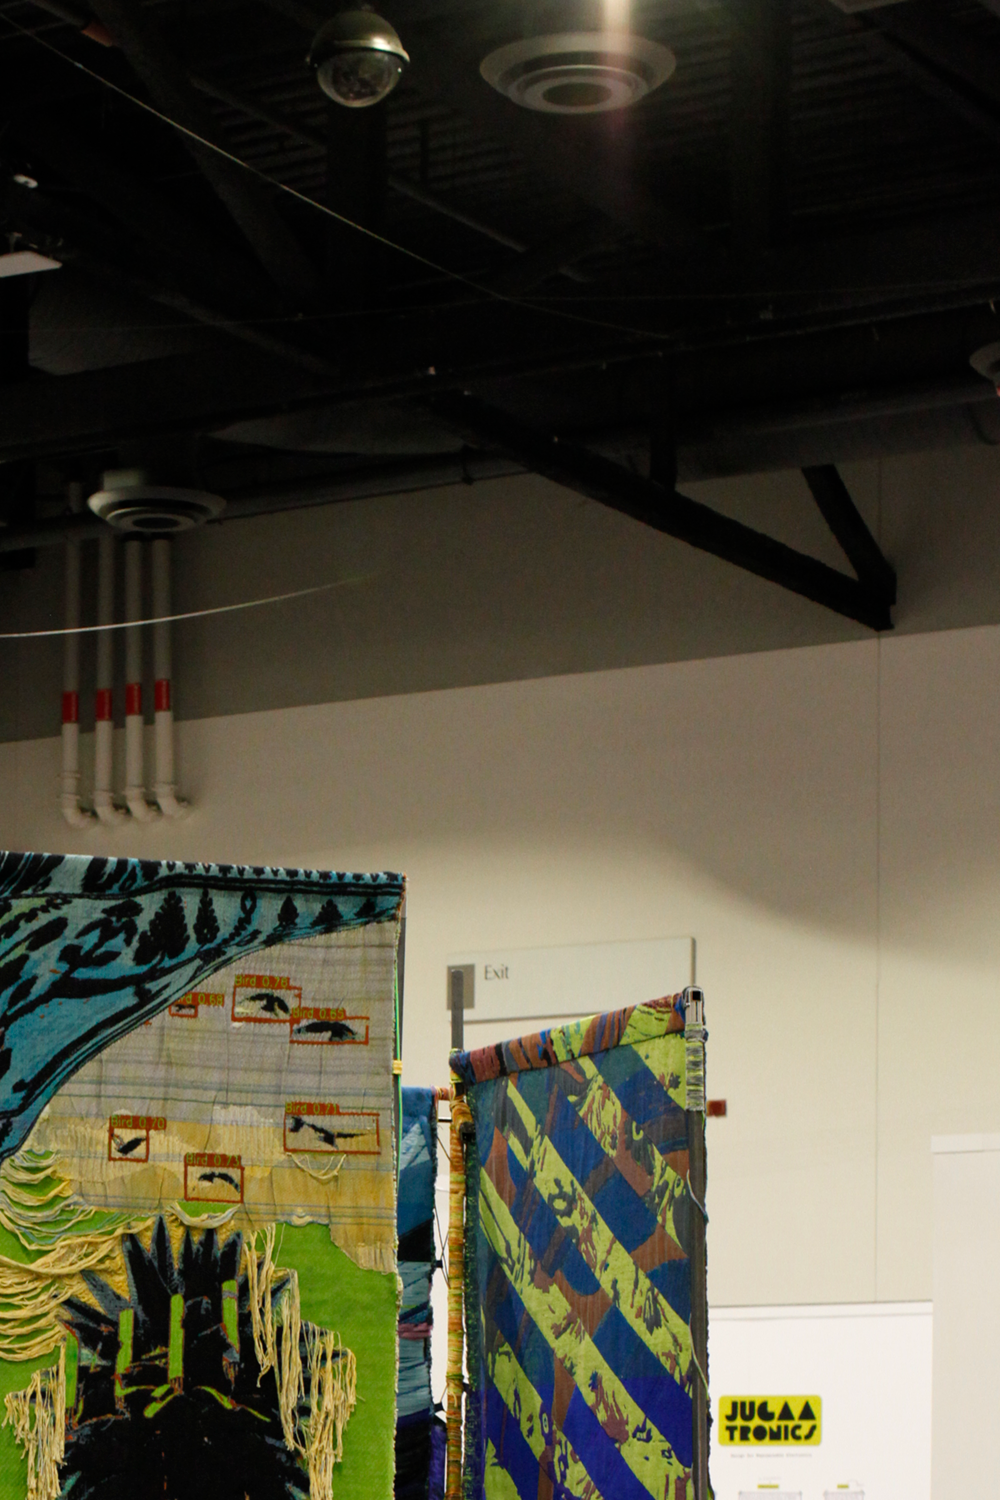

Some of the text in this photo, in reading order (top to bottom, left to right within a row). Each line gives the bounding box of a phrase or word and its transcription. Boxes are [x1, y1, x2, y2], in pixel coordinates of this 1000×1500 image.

[484, 963, 509, 980] Exit
[235, 974, 257, 986] Bird
[292, 1006, 314, 1018] Bird
[285, 1102, 338, 1115] Bird 0.71
[111, 1114, 165, 1129] Bird 0.70
[186, 1152, 208, 1165] Bird
[725, 1400, 816, 1422] JUGAA
[725, 1424, 817, 1441] TRONICS
